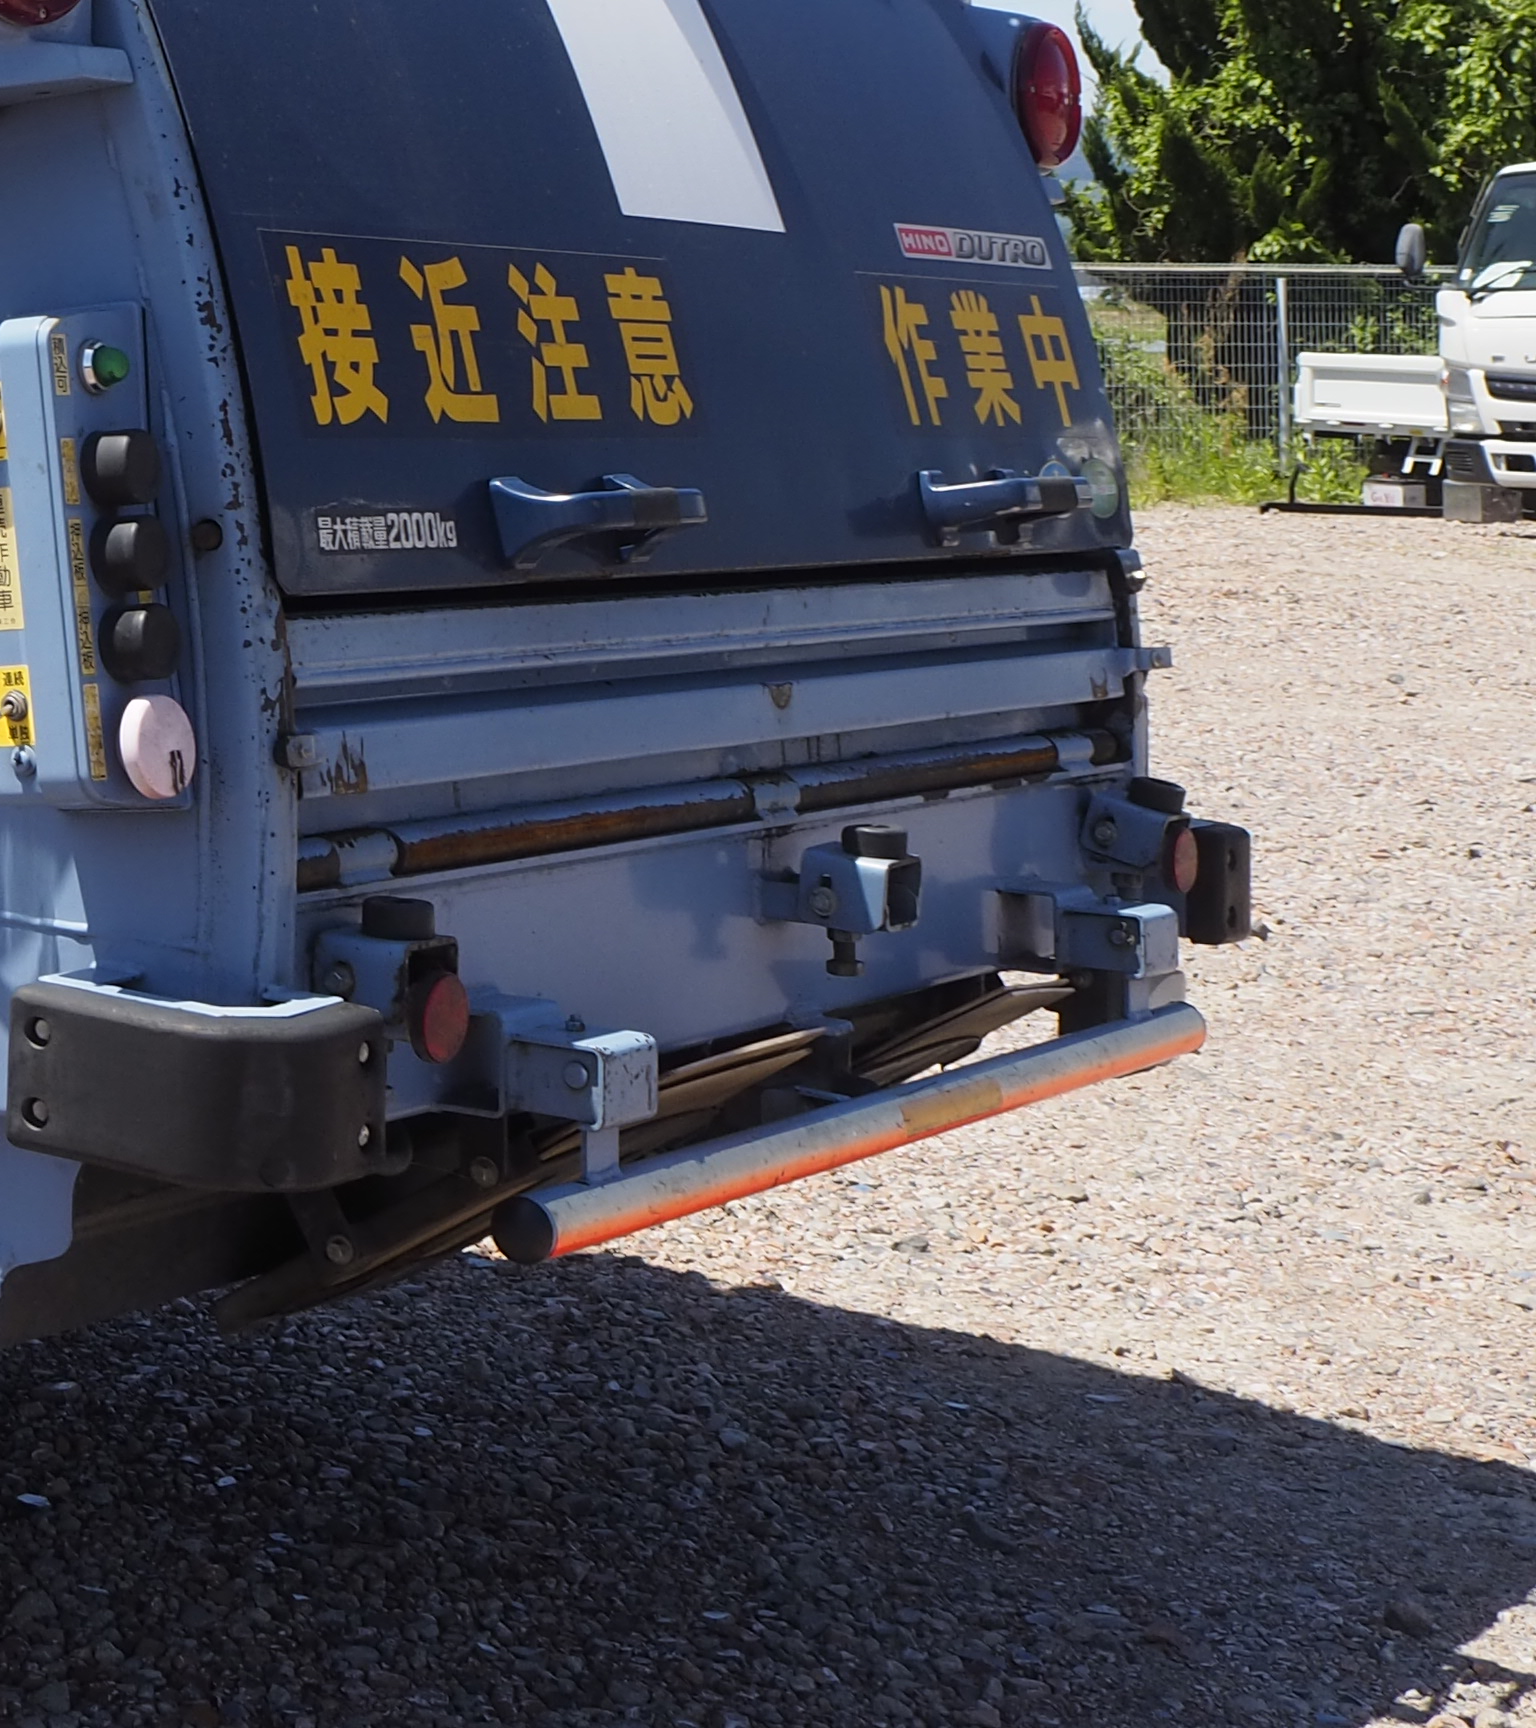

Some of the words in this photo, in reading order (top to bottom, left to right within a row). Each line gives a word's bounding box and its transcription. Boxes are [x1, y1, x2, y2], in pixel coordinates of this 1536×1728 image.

[901, 231, 950, 254] HINO
[954, 232, 1047, 267] DUTRO
[284, 244, 695, 426] 接近注意
[882, 283, 1082, 429] 作業中
[52, 337, 68, 393] 積込可
[317, 511, 458, 551] 最大積載量2000kg
[2, 671, 24, 687] 連続
